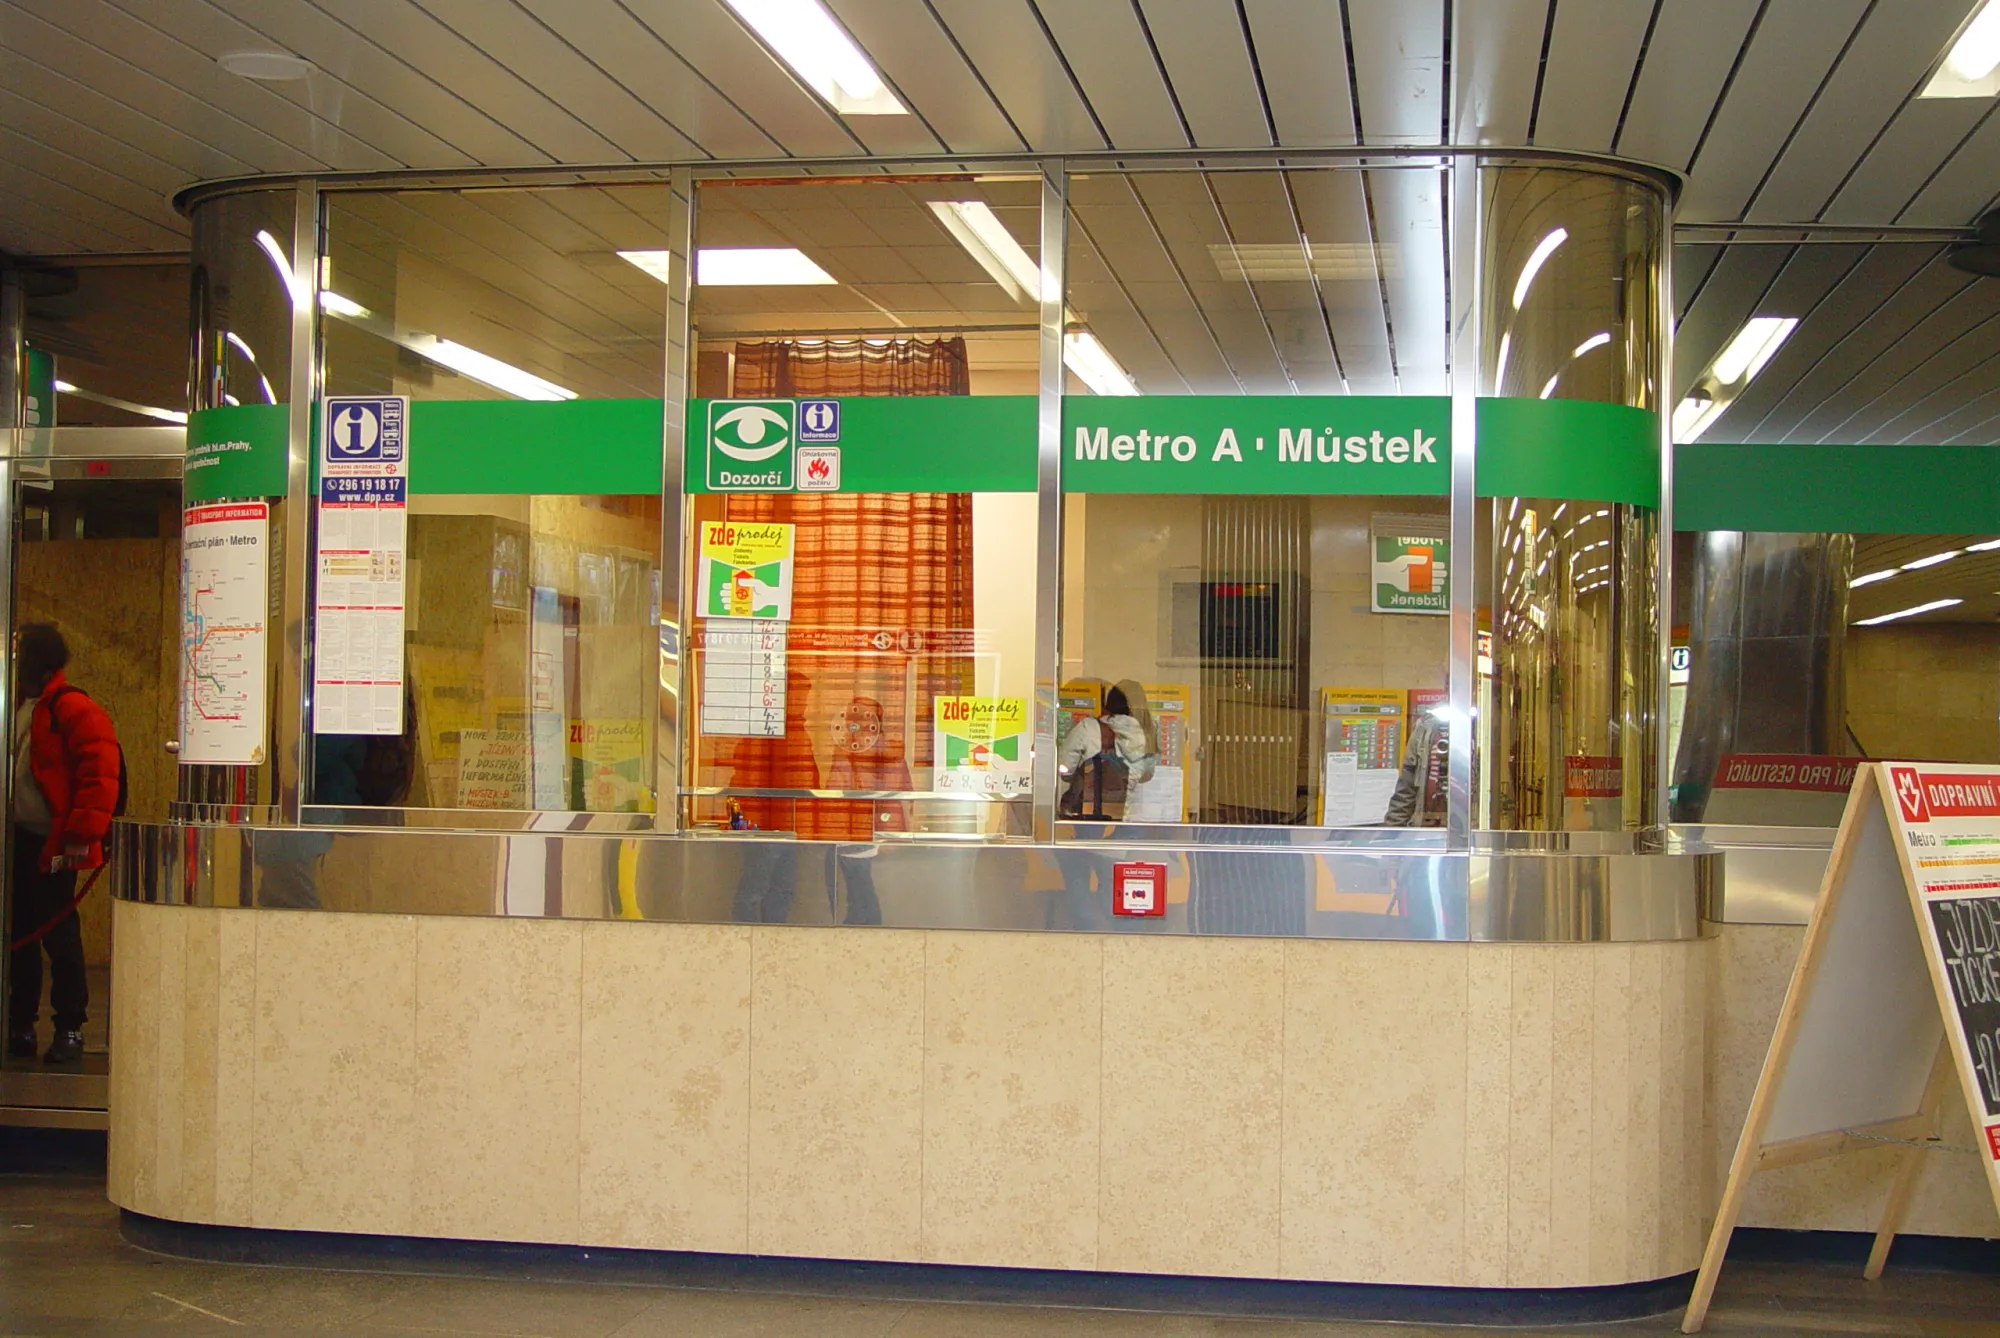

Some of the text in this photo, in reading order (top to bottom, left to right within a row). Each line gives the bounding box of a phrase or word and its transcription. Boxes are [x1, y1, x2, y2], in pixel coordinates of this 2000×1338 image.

[1075, 427, 1437, 464] Metro A Můstek
[338, 479, 400, 491] 296 19 18 17
[720, 471, 782, 485] Dozorčí
[338, 492, 396, 503] www.dpp.cz
[225, 508, 263, 517] INFORMATION
[709, 522, 783, 546] zde prodej
[208, 536, 225, 549] plán
[230, 536, 257, 546] Metro
[943, 697, 1019, 721] zde prodej
[1003, 774, 1017, 791] 4,-
[1019, 776, 1031, 788] Kč
[1928, 780, 1998, 808] DOPRAVNÍ
[1908, 831, 1936, 847] Metro
